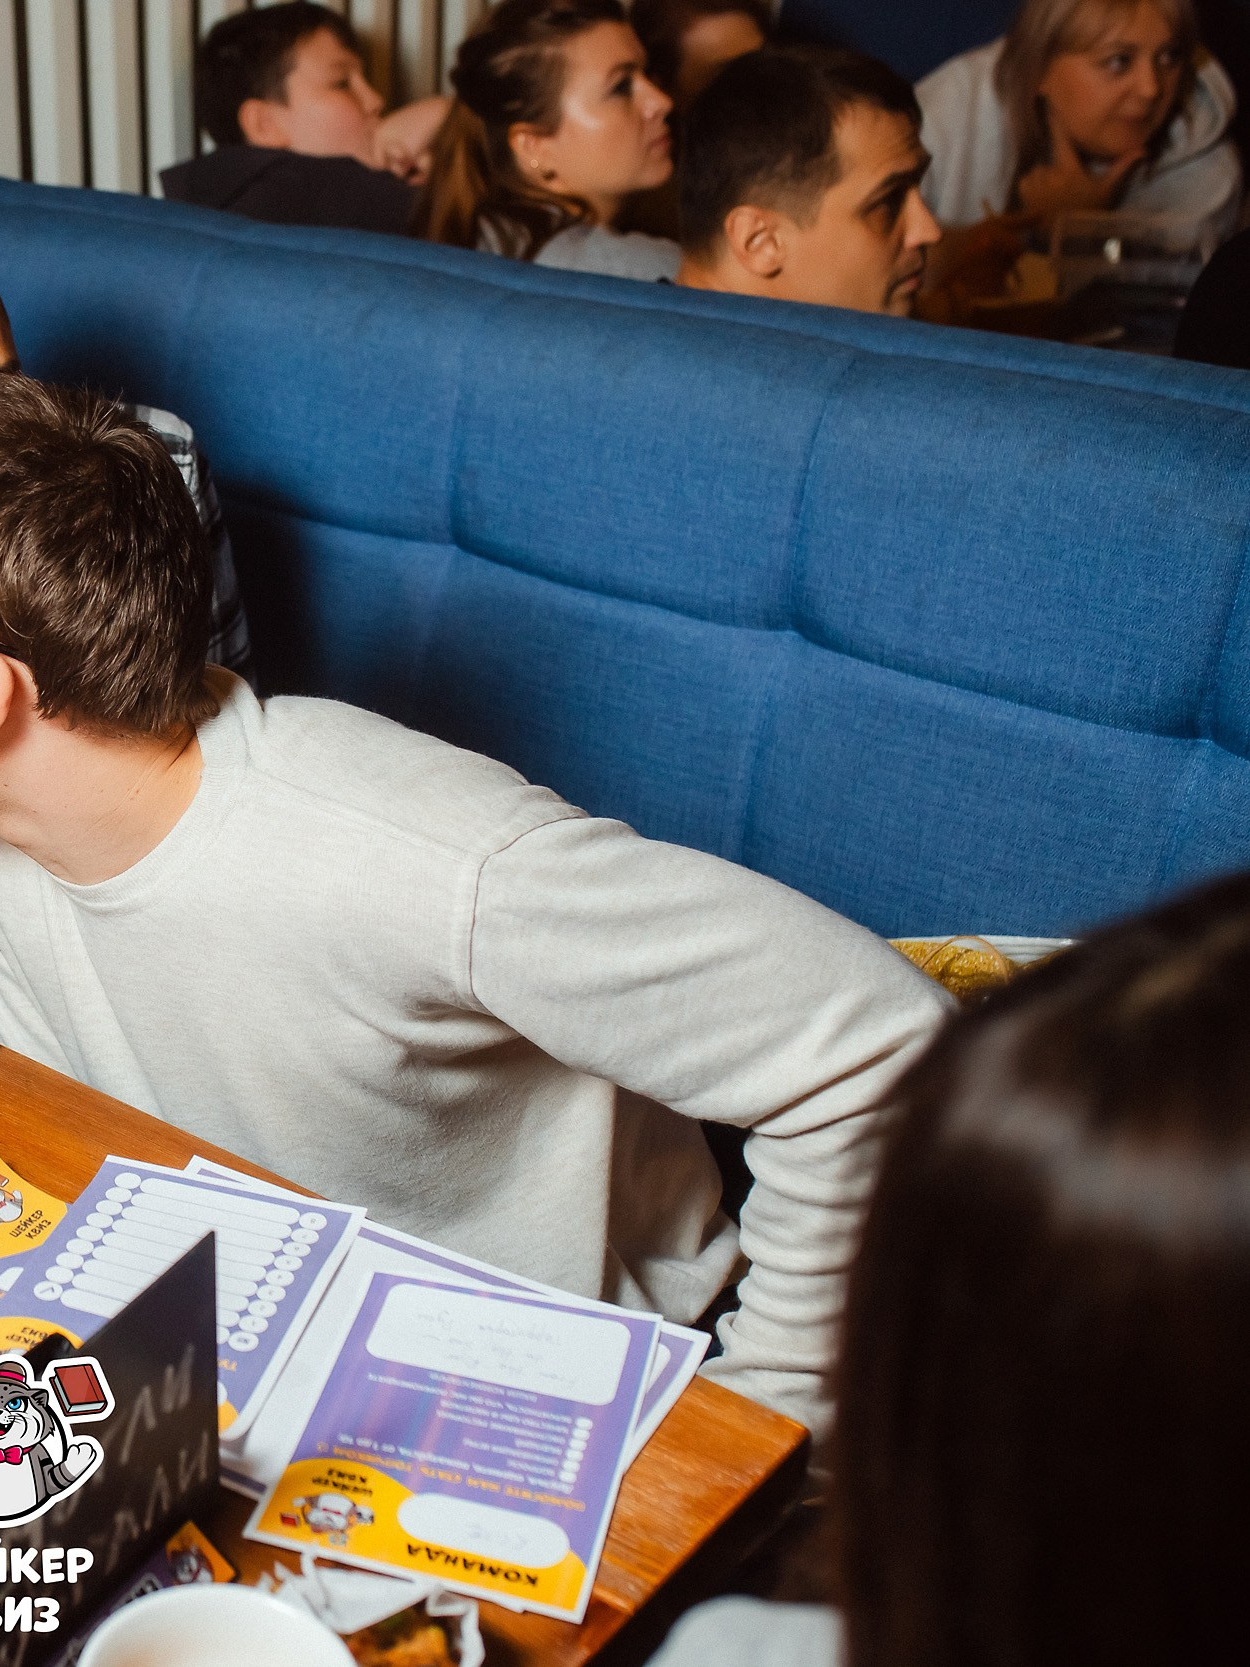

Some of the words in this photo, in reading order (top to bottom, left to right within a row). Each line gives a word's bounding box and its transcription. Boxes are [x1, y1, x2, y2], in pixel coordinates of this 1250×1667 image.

[9, 1209, 45, 1239] ШЕЙКЕР
[25, 1220, 52, 1240] КВИЗ
[406, 1542, 540, 1588] КОМАНДА
